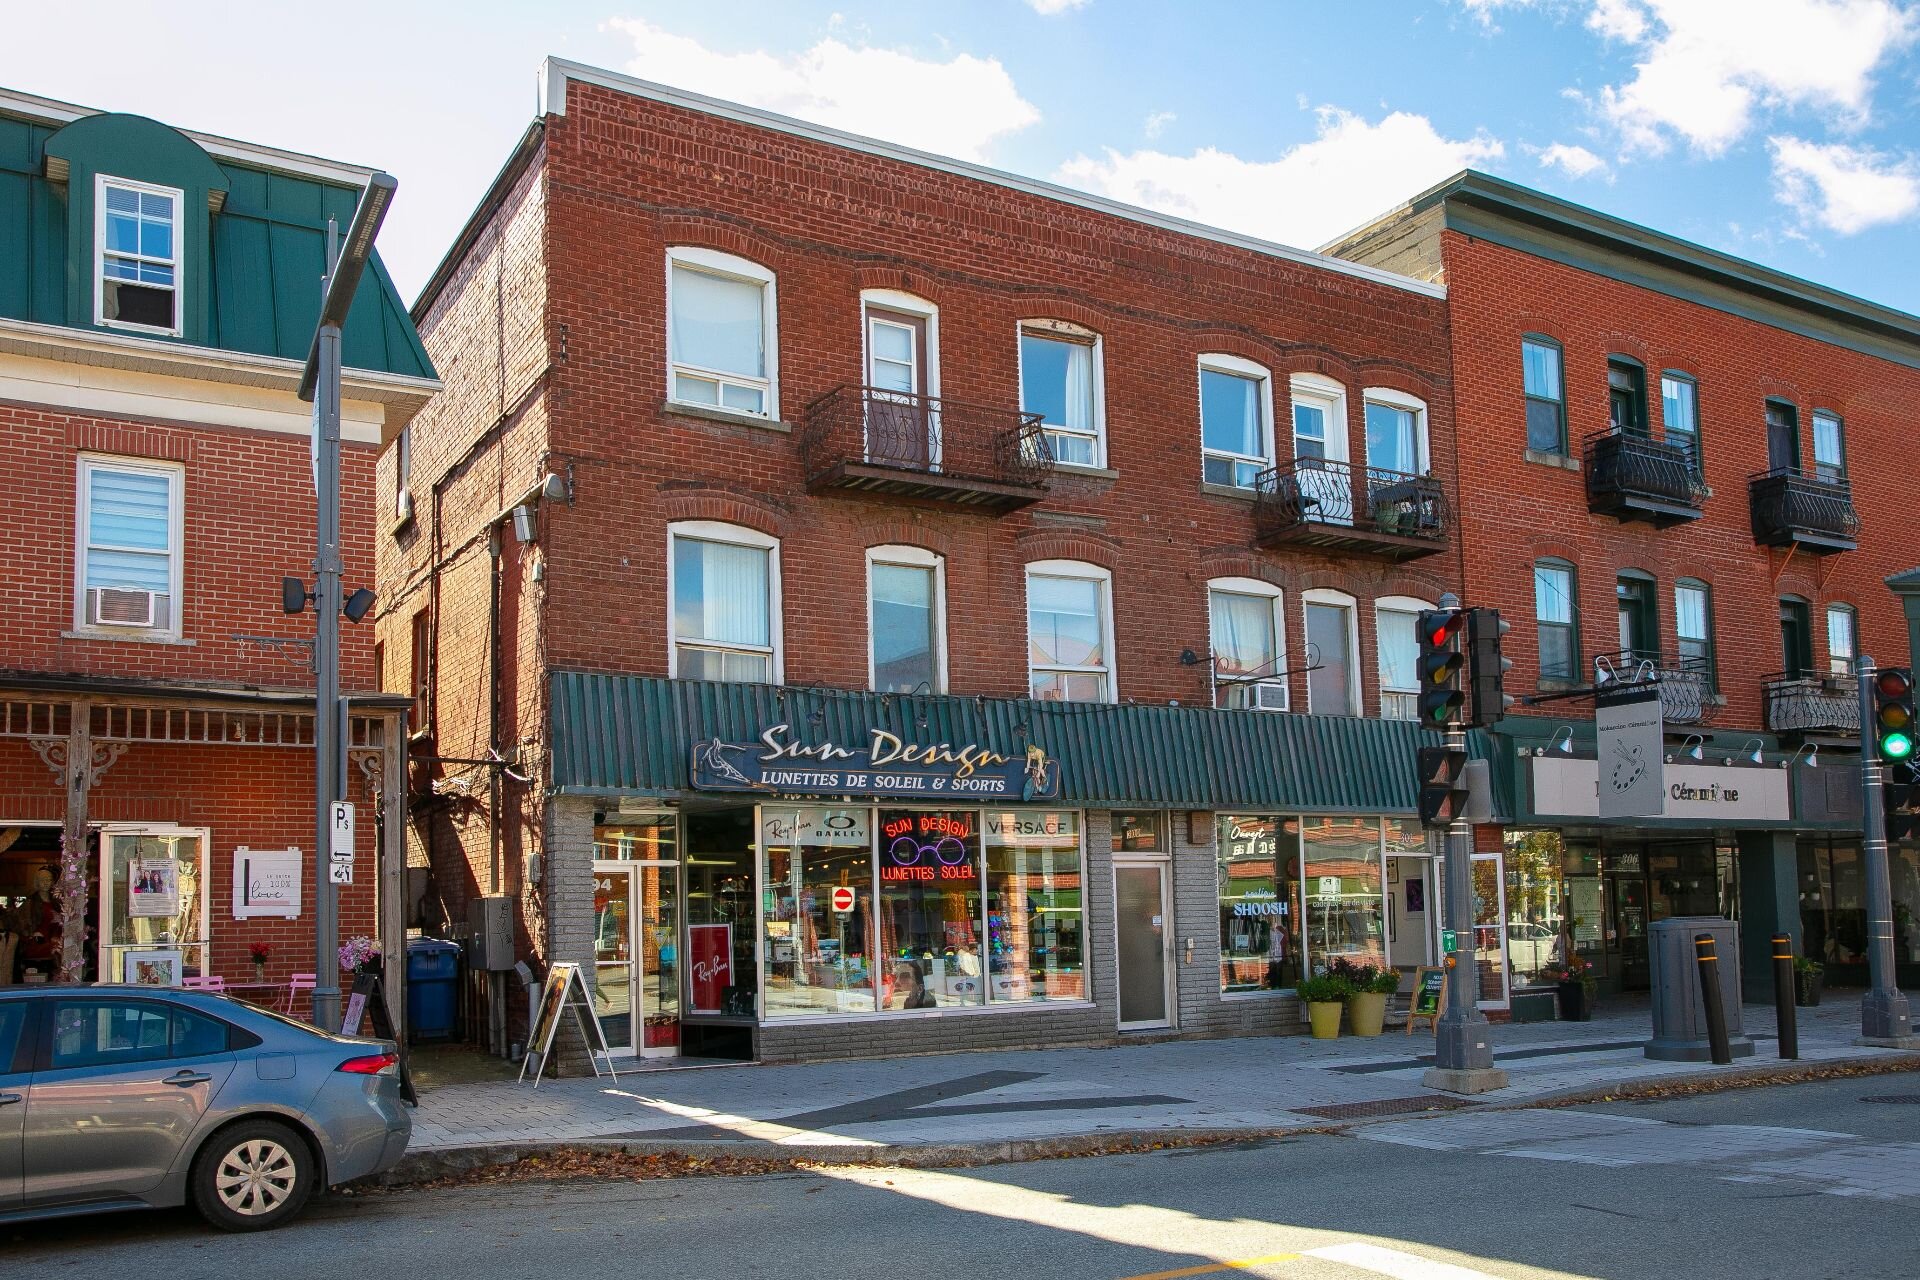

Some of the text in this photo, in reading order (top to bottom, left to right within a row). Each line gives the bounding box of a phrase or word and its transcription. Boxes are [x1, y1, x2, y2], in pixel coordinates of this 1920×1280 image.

[760, 724, 1011, 778] Sun Design
[760, 771, 1006, 792] LUNETTES DE SOLEIL & SPORTS
[885, 817, 969, 838] SUN DESIGN
[987, 821, 1068, 835] VERSACE
[1621, 853, 1639, 864] 306
[881, 866, 976, 880] LUNETTES SOLEIL
[251, 879, 284, 899] love
[1233, 901, 1289, 916] SHOOSH
[693, 955, 728, 982] Ray-Ban
